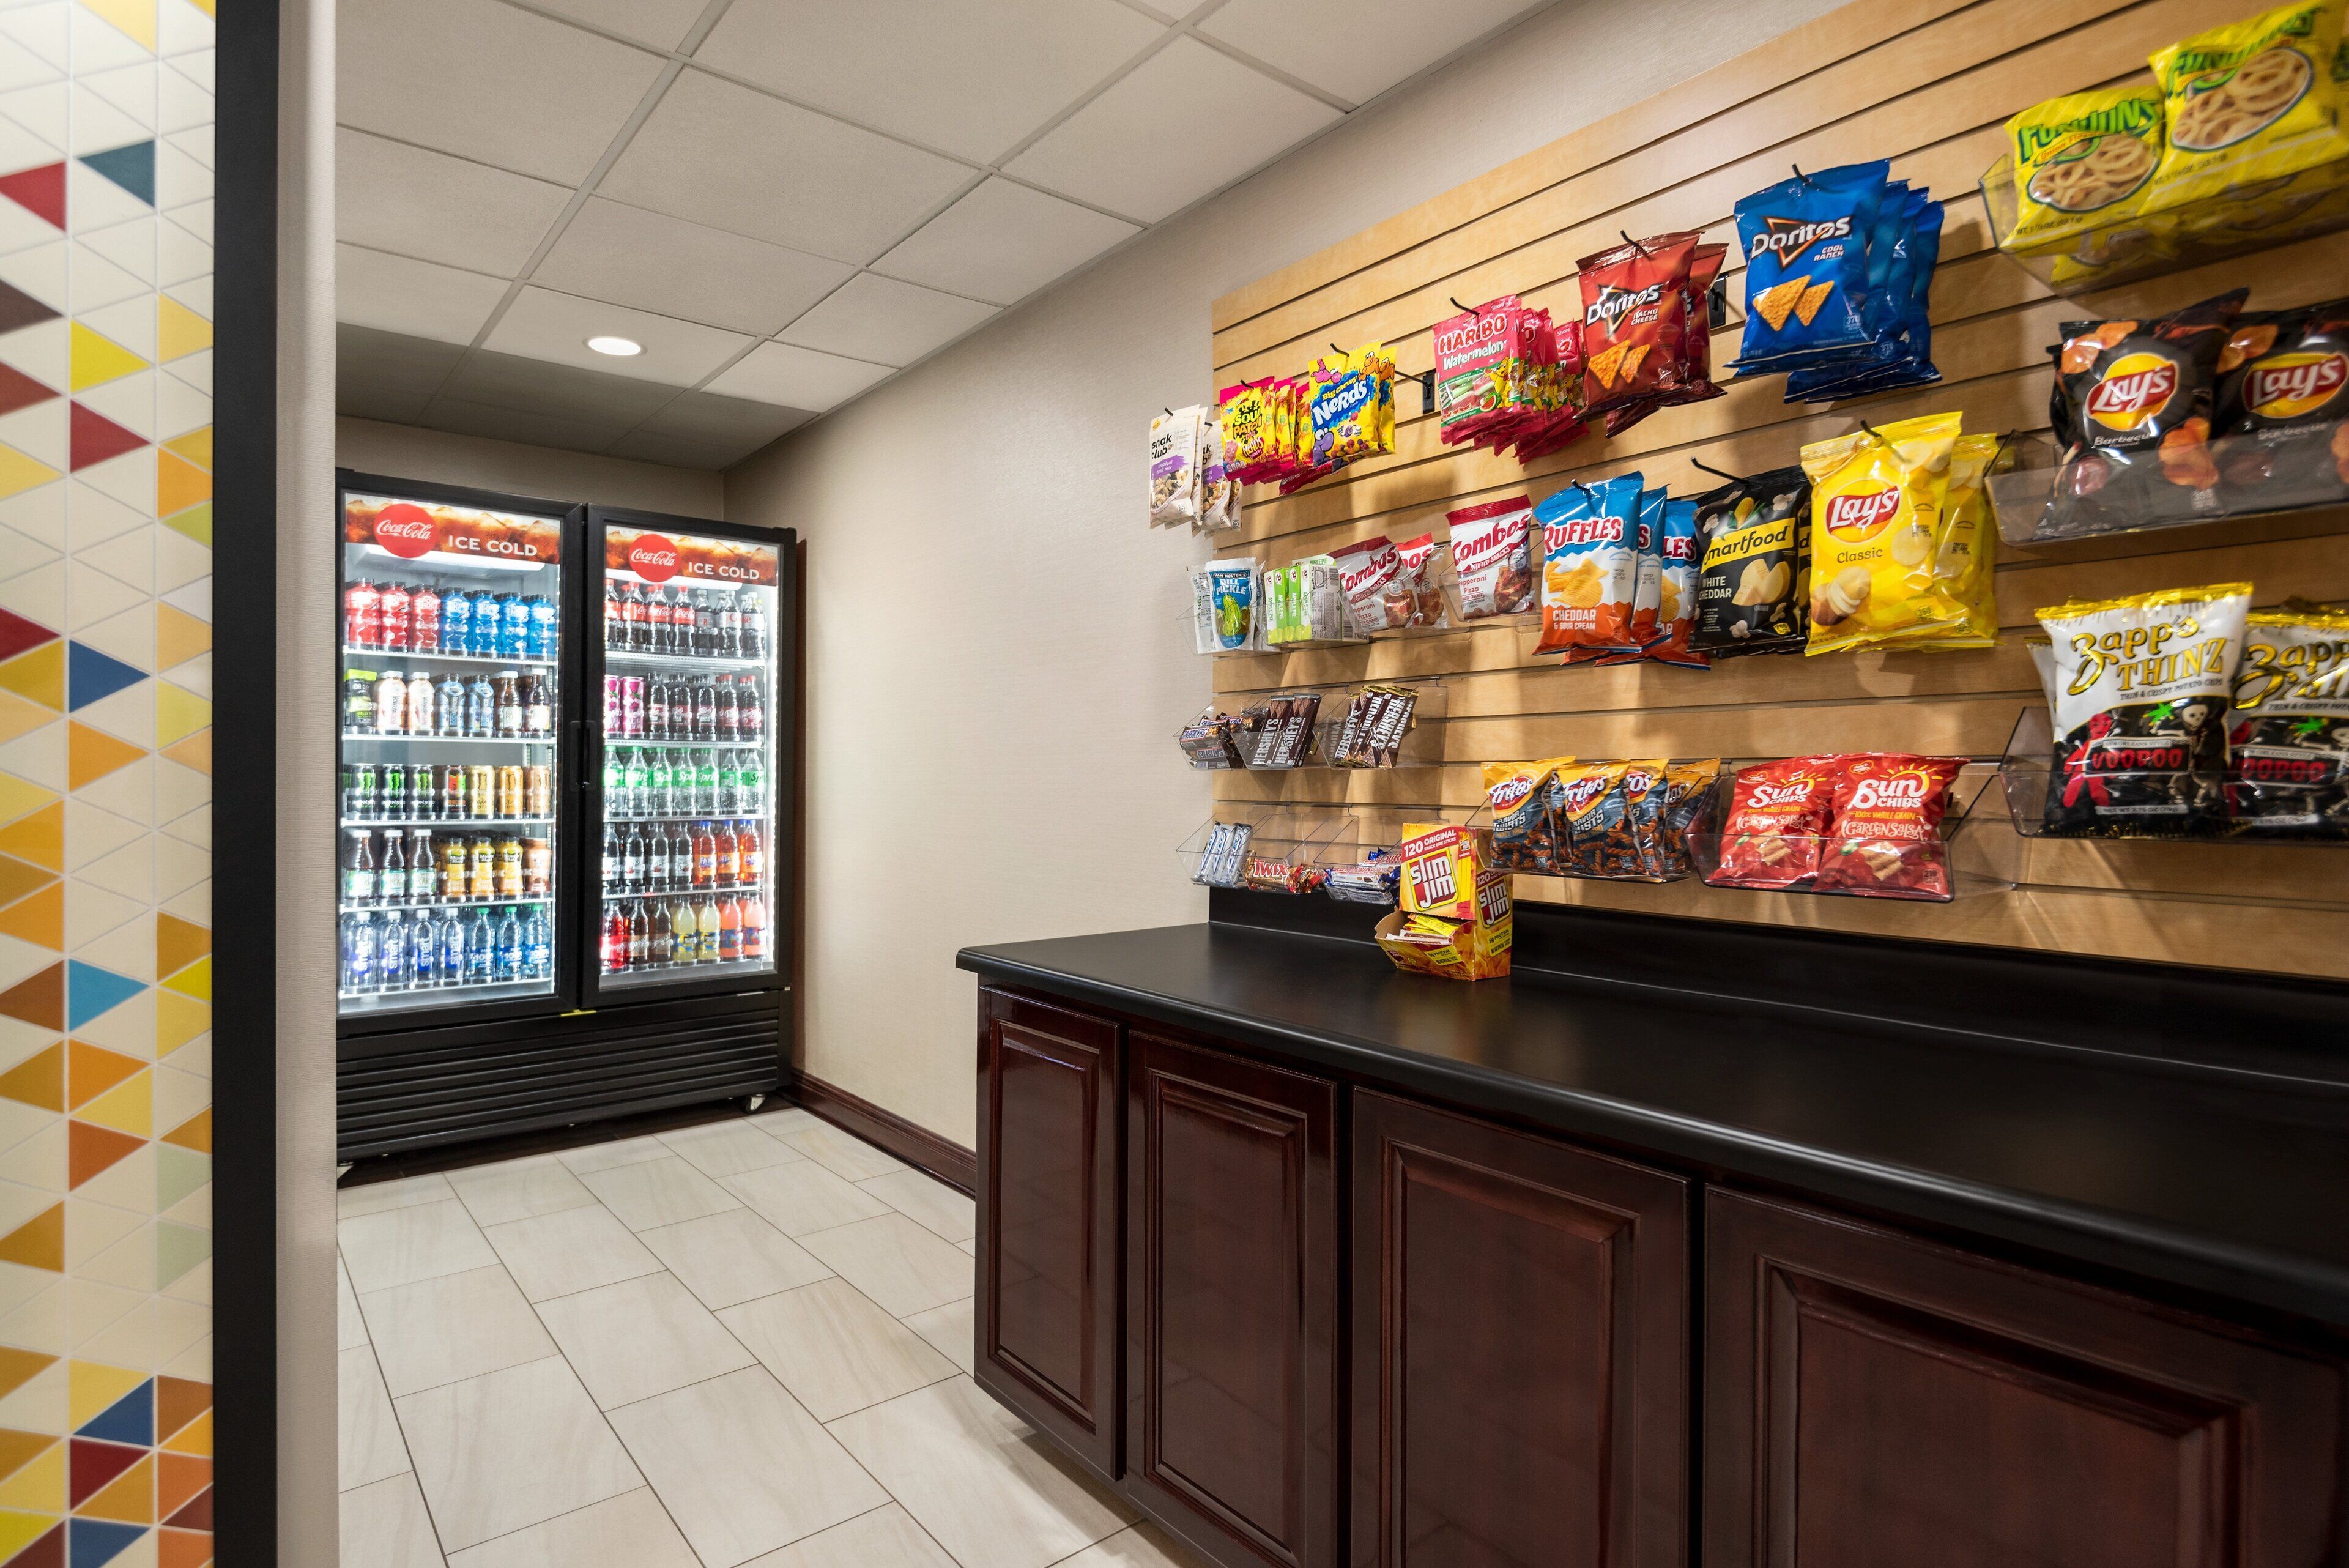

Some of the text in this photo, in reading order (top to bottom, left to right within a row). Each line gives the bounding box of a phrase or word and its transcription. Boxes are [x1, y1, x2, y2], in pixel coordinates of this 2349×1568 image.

[1751, 216, 1852, 258] Doritos
[1814, 250, 1844, 262] RANCH
[1822, 245, 1844, 255] COOL
[1586, 284, 1663, 324] Doritos
[1633, 308, 1659, 320] NACHO
[1631, 314, 1658, 325] CHEESE
[1438, 313, 1507, 355] HARIBO
[1443, 340, 1505, 370] Watermelon
[1323, 376, 1358, 401] Big chewy
[2091, 366, 2173, 413] Lay's
[2252, 359, 2342, 404] Lay's
[1152, 433, 1172, 449] snak
[1829, 489, 1900, 529] Lay's
[376, 519, 434, 540] Coca-Cola
[1543, 518, 1623, 554] RUFFLES
[448, 535, 538, 557] ICE COLD
[1490, 546, 1510, 563] SNACKS
[1836, 548, 1883, 563] Classic
[631, 548, 677, 566] Coca-Cola
[689, 562, 760, 579] ICE COLD
[1216, 585, 1247, 596] PICKLE
[1702, 576, 1726, 587] WHITE
[1699, 588, 1732, 600] CHEDDAR
[1553, 609, 1596, 622] CHEDDAR
[2067, 616, 2200, 696] Zapp's
[2116, 638, 2227, 692] THINZ
[2232, 639, 2349, 709] Zapp
[2146, 687, 2173, 699] CRISPY
[2093, 748, 2183, 769] VOODOO
[1489, 778, 1533, 805] Fritos
[1747, 781, 1813, 808] Sun
[1769, 795, 1806, 804] CHIPS
[1852, 779, 1928, 809] Sun
[1877, 797, 1922, 808] CHIPS
[1493, 812, 1526, 831] TWISTS
[1498, 810, 1520, 824] FLAVOR
[1575, 809, 1605, 834] ISTS
[1404, 841, 1423, 858] 120
[1424, 829, 1456, 845] ORIGINAL
[1477, 873, 1490, 886] 120
[1494, 929, 1509, 940] PROTEIN
